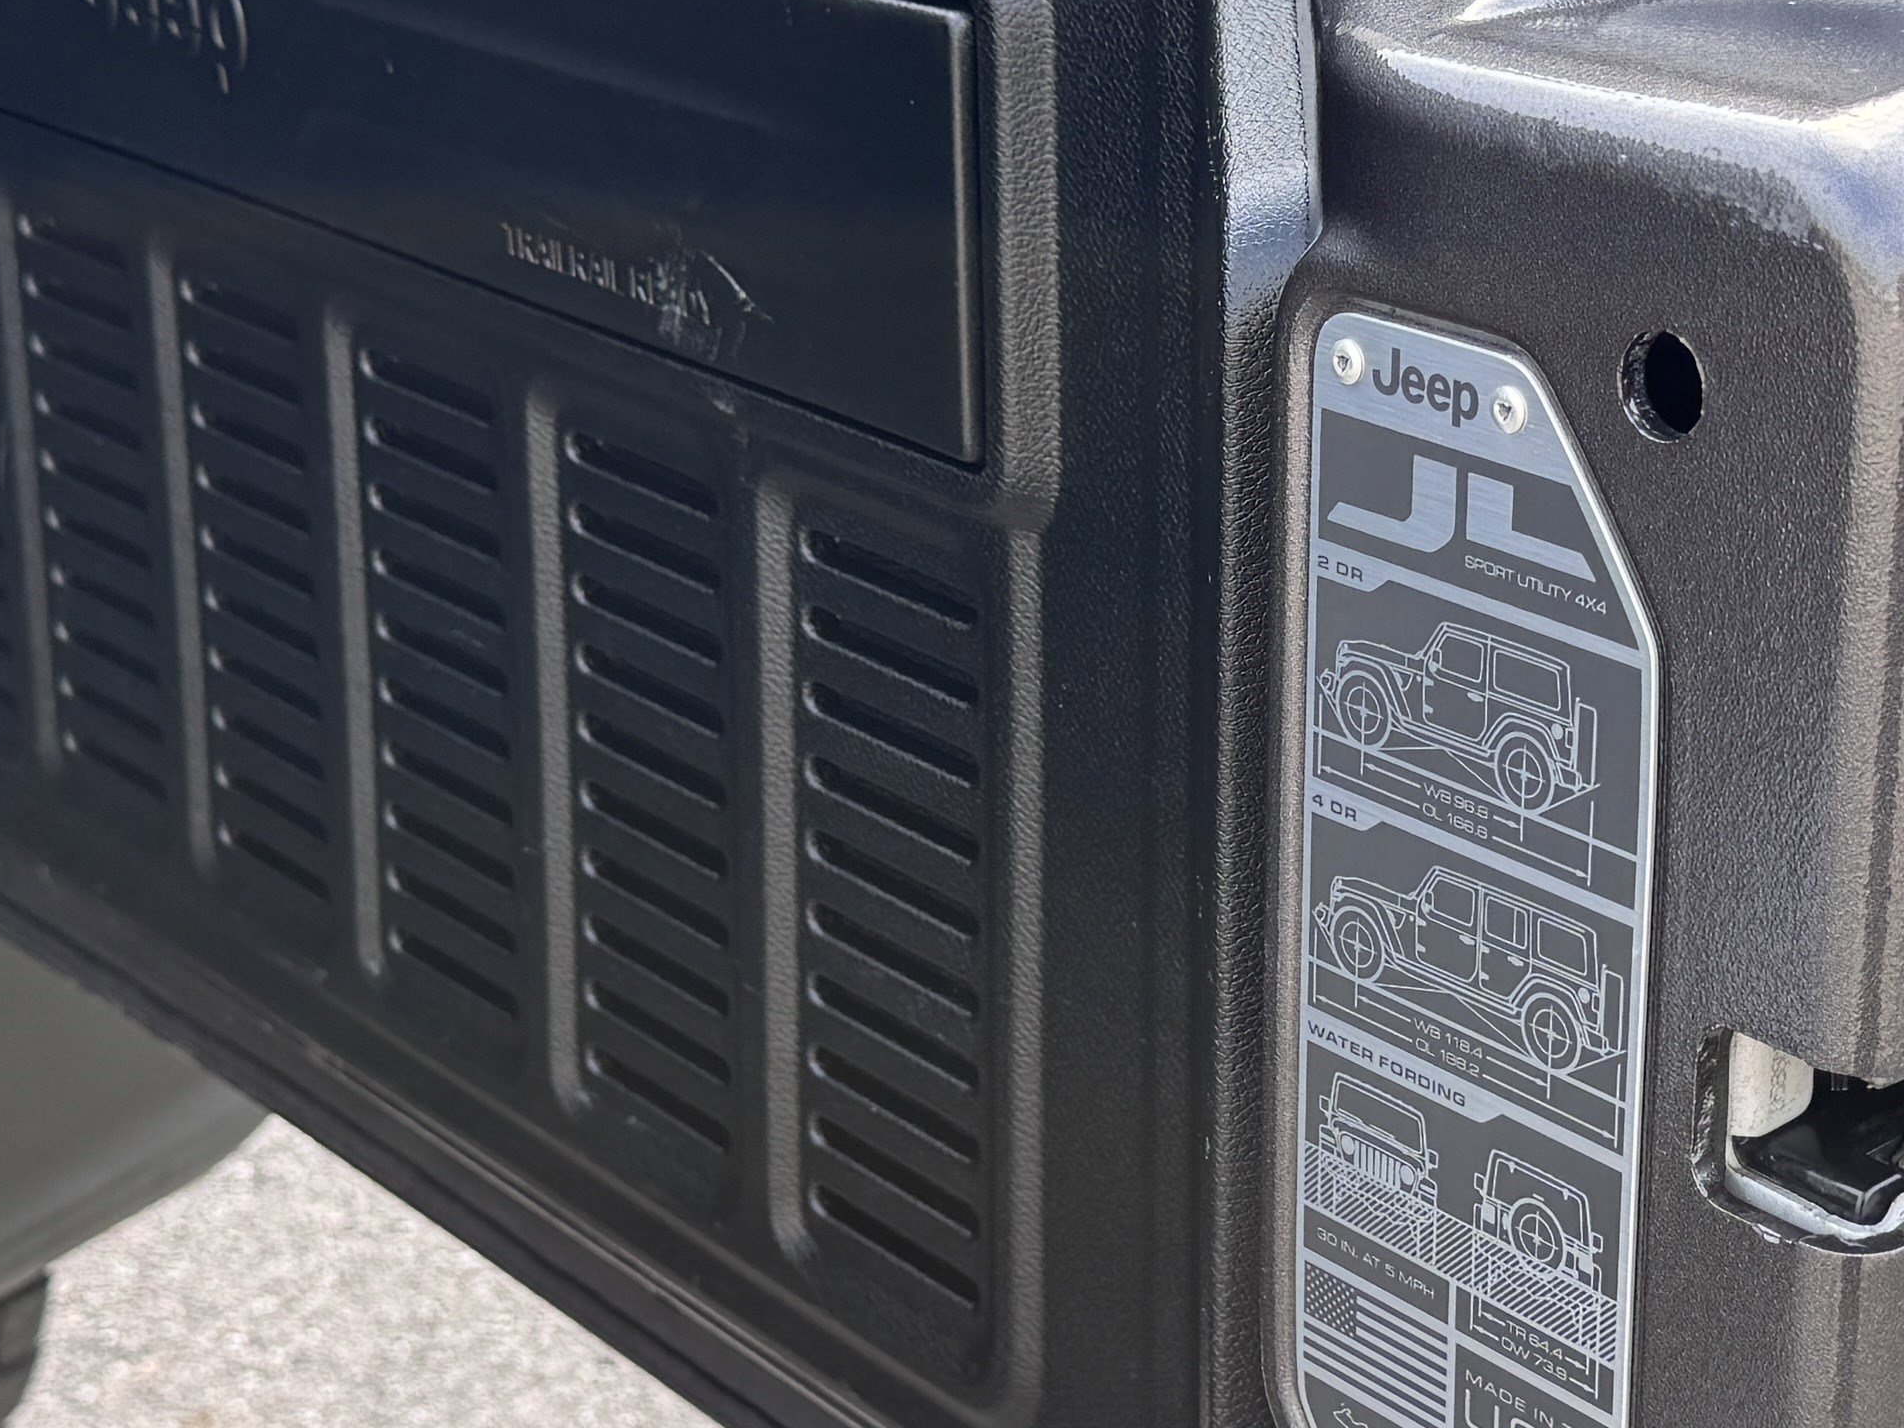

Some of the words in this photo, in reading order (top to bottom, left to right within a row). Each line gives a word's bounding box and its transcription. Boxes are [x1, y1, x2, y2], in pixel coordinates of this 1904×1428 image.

[1371, 346, 1480, 428] Jeep
[1326, 453, 1597, 584] JL
[1317, 554, 1329, 570] 2
[1336, 560, 1364, 583] DR
[1464, 555, 1514, 585] SPORT
[1517, 571, 1572, 603] UTILITY
[1575, 589, 1607, 616] 4X4
[1312, 794, 1325, 807] 4
[1331, 800, 1358, 822] DR
[1423, 782, 1452, 804] WB
[1413, 1017, 1441, 1040] WB
[1307, 1019, 1374, 1064] WATER
[1379, 1055, 1467, 1108] FORDING
[1317, 1226, 1338, 1247] 30
[1363, 1252, 1381, 1268] AT
[1384, 1263, 1395, 1278] 5
[1398, 1270, 1435, 1300] MPH
[1506, 1320, 1527, 1341] TR
[1465, 1369, 1527, 1414] MADE
[1534, 1407, 1554, 1428] IN
